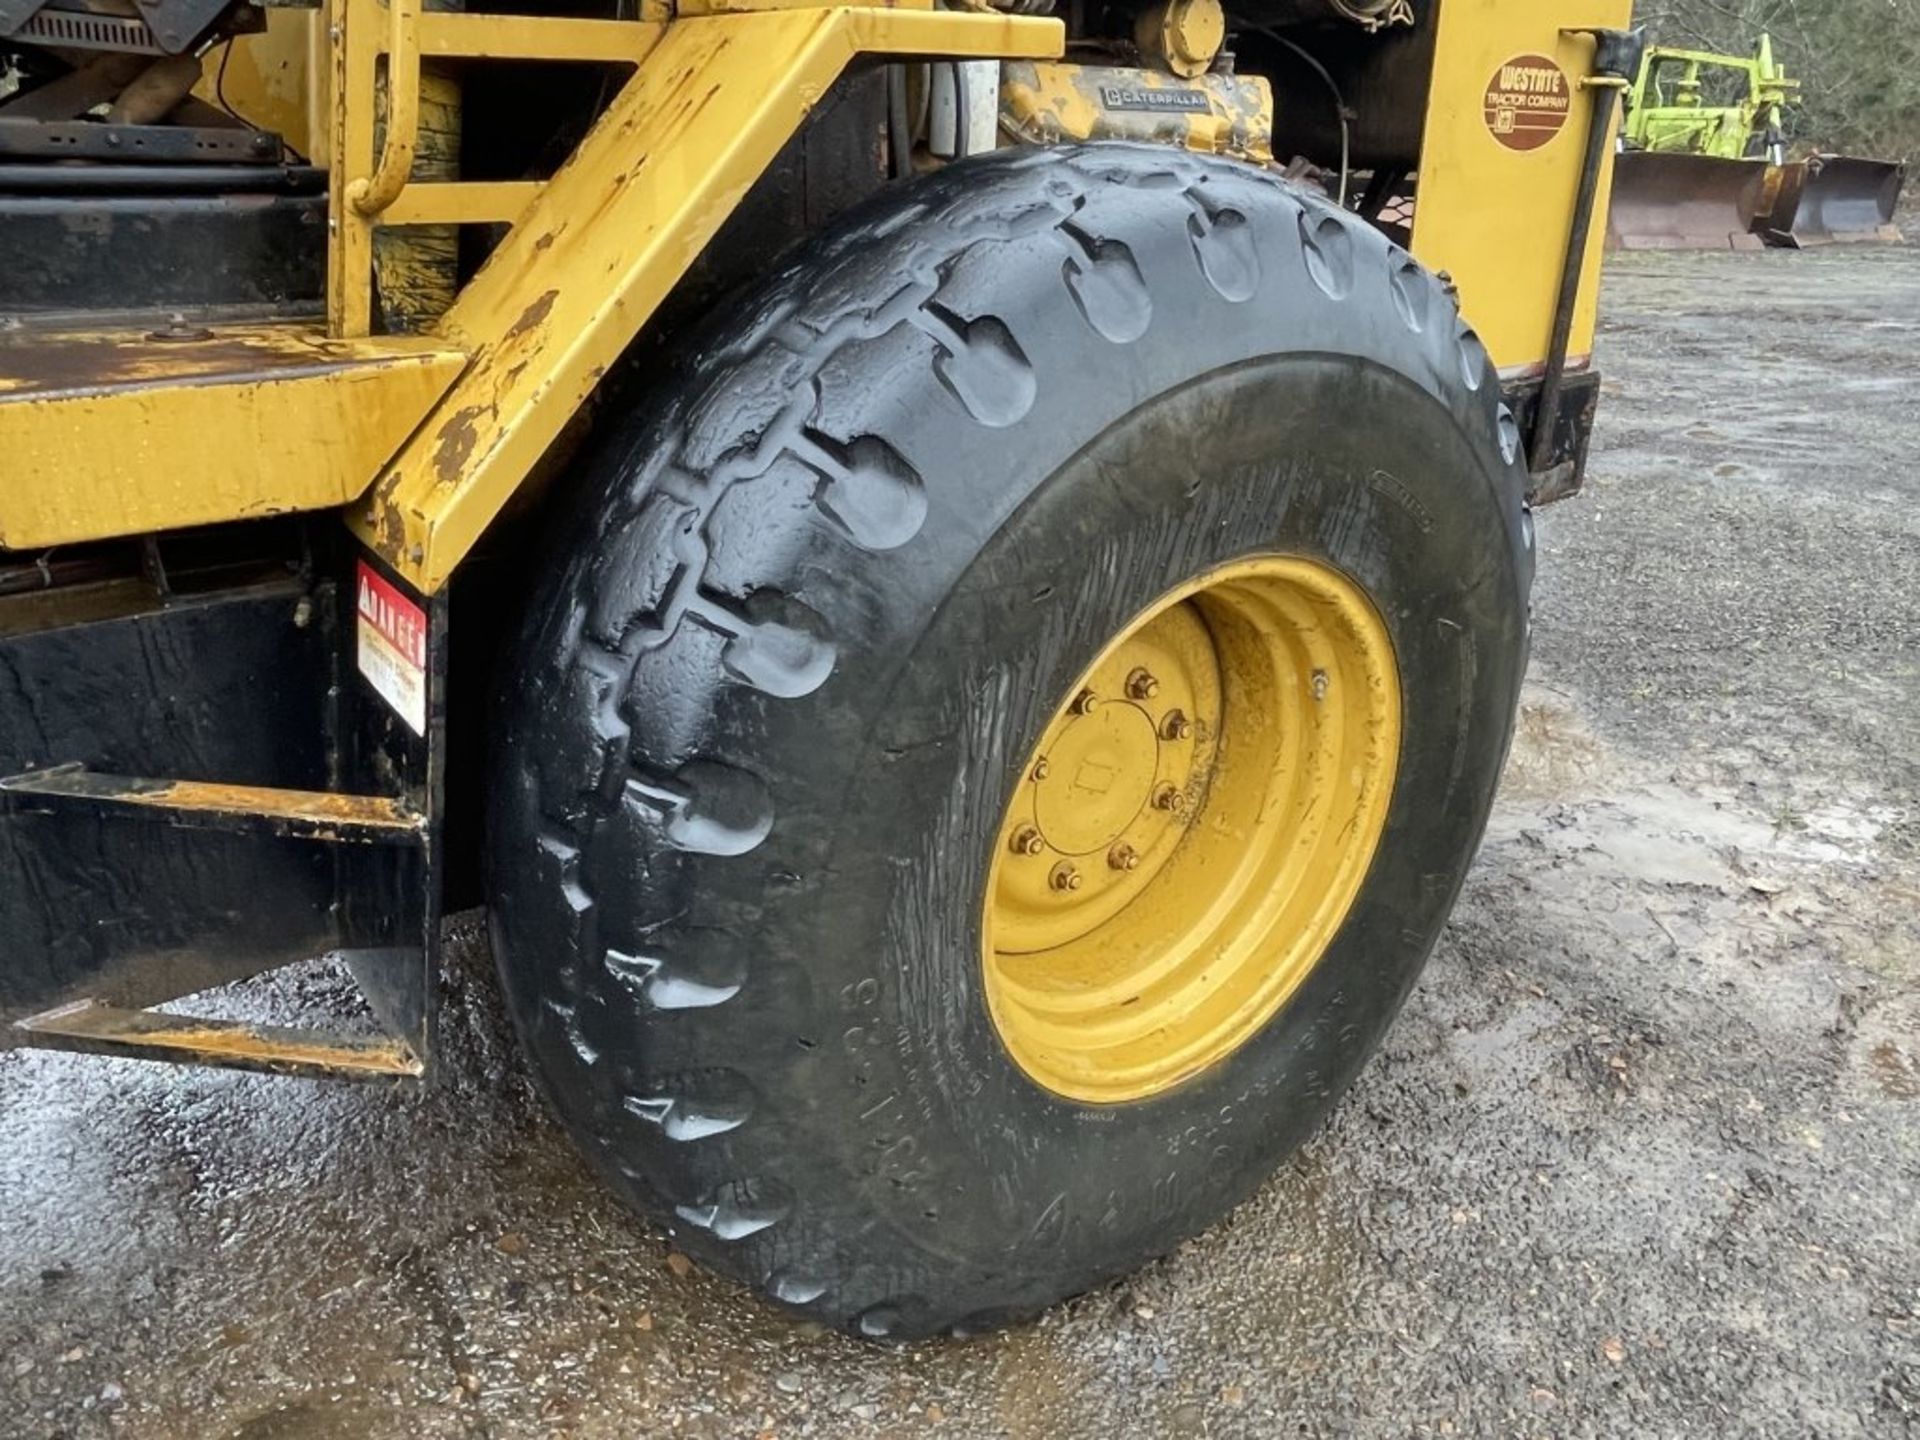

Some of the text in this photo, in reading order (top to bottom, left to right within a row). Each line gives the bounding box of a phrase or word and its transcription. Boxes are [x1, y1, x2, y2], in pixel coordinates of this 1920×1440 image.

[1500, 66, 1561, 92] WESTATE
[1123, 91, 1207, 106] CATERPILLAR
[1488, 93, 1568, 109] TRACTOR COMPANY
